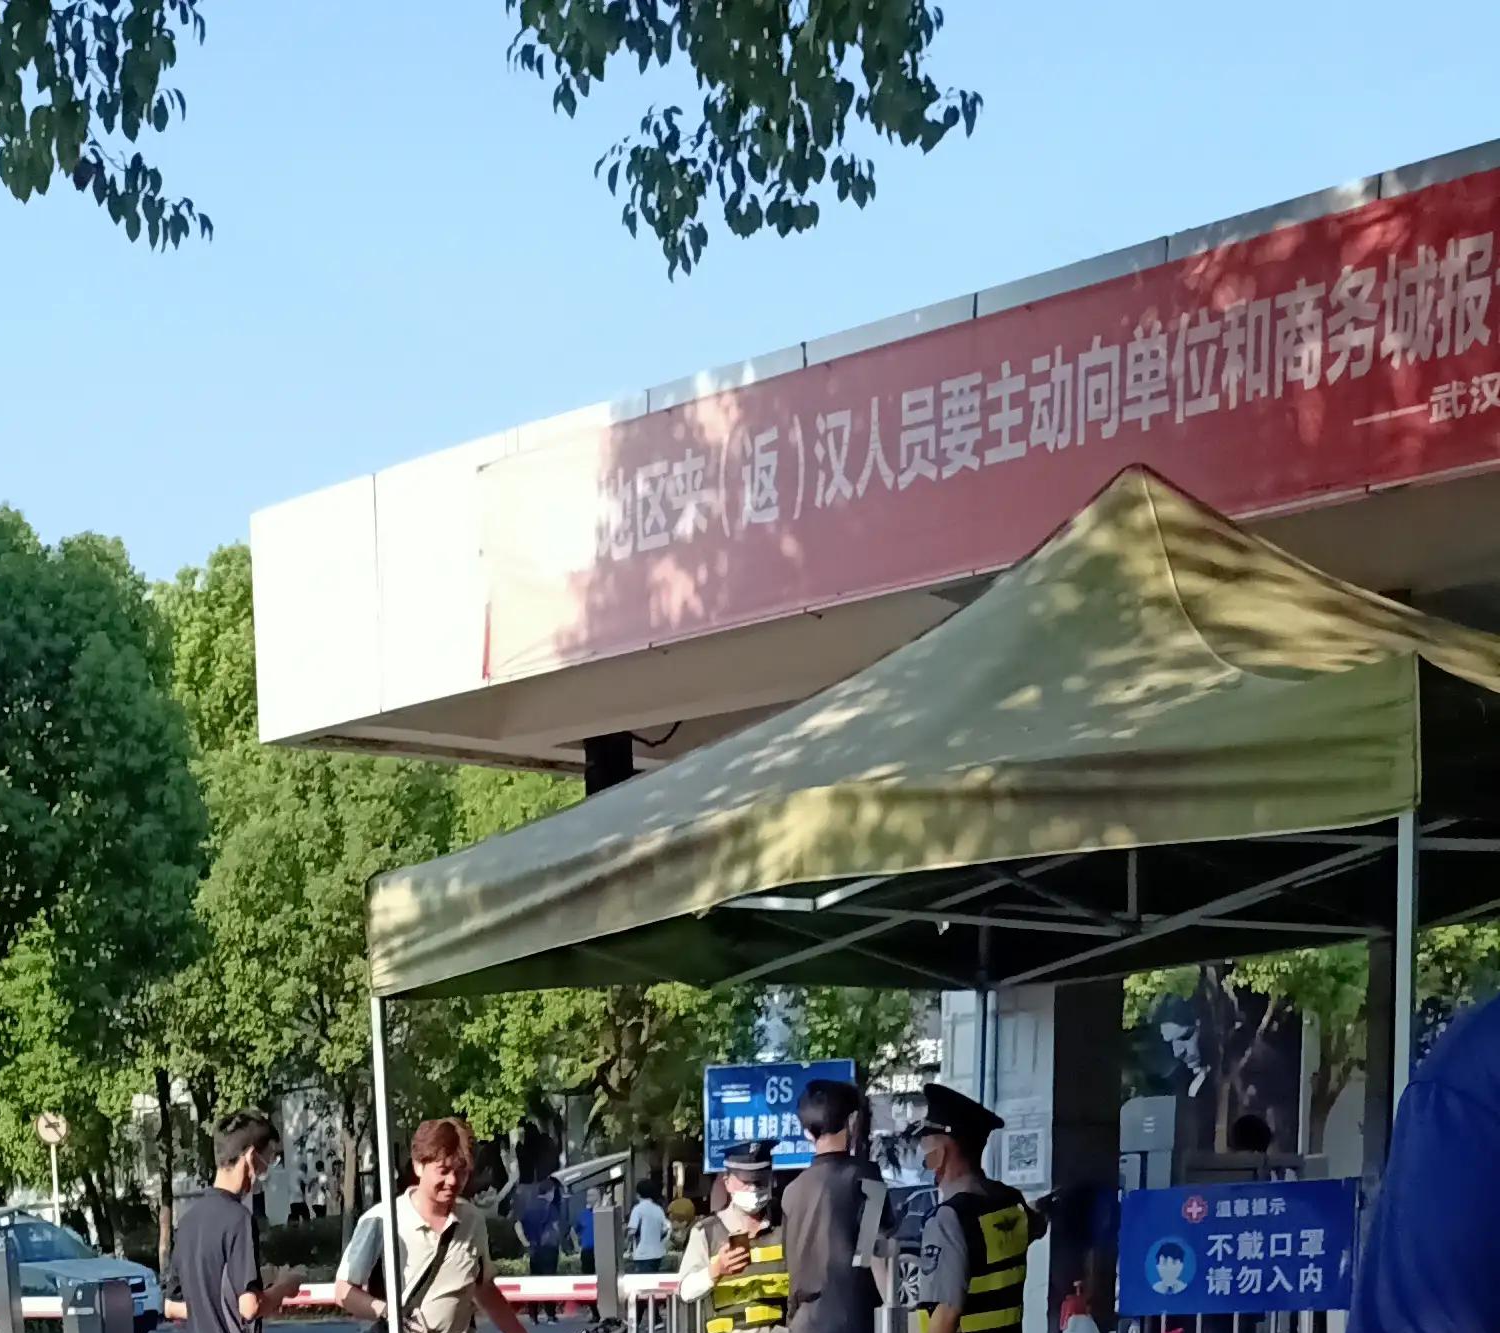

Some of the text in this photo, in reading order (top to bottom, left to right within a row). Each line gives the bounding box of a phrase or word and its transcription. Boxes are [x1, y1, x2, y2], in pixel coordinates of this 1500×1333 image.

[598, 232, 1500, 561] 地区来（返）汉人员要主动向单位和商务城报
[765, 1075, 794, 1105] 6S
[1216, 1197, 1286, 1217] 温馨提示
[1206, 1229, 1326, 1261] 不戴口罩
[1206, 1263, 1324, 1295] 请勿入内
